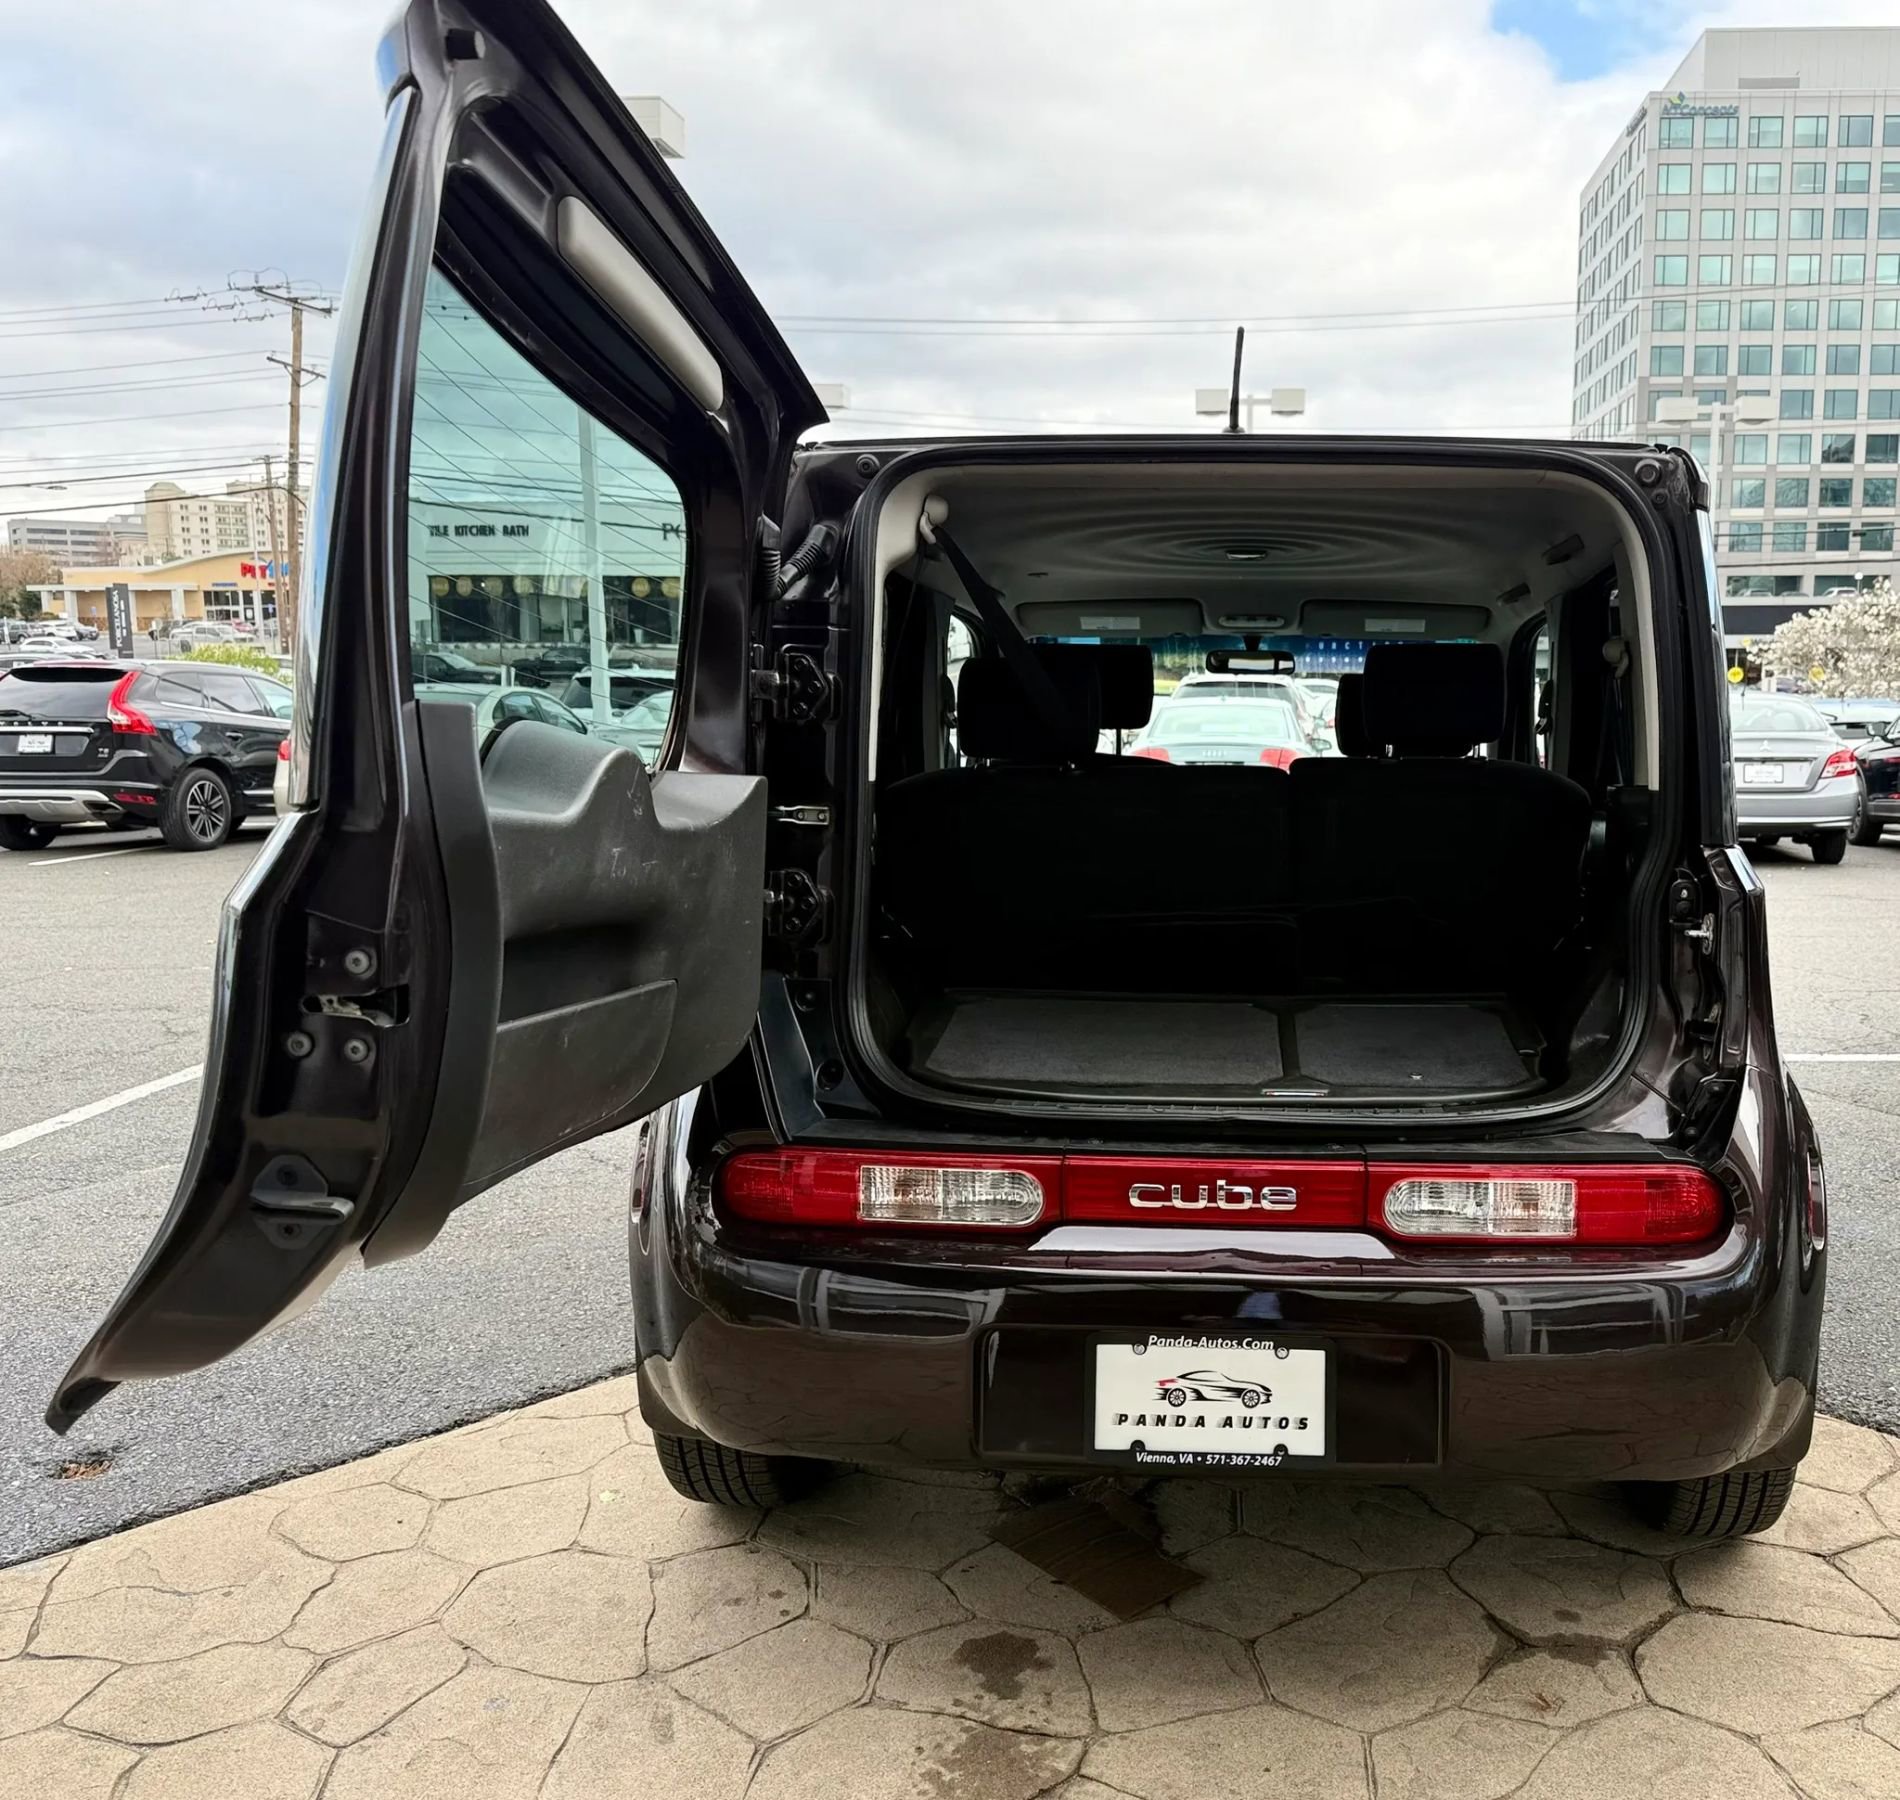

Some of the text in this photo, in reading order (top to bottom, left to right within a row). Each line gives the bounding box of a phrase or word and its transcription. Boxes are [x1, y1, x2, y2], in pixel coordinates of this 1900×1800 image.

[429, 525, 529, 537] TILE KITCHEN BATH
[1129, 1179, 1297, 1210] cube
[1148, 1335, 1274, 1350] Panda-Autos.Com
[1115, 1413, 1309, 1430] PANDA AUTOS
[1136, 1452, 1283, 1467] Vienna, VA 571-367-2467
